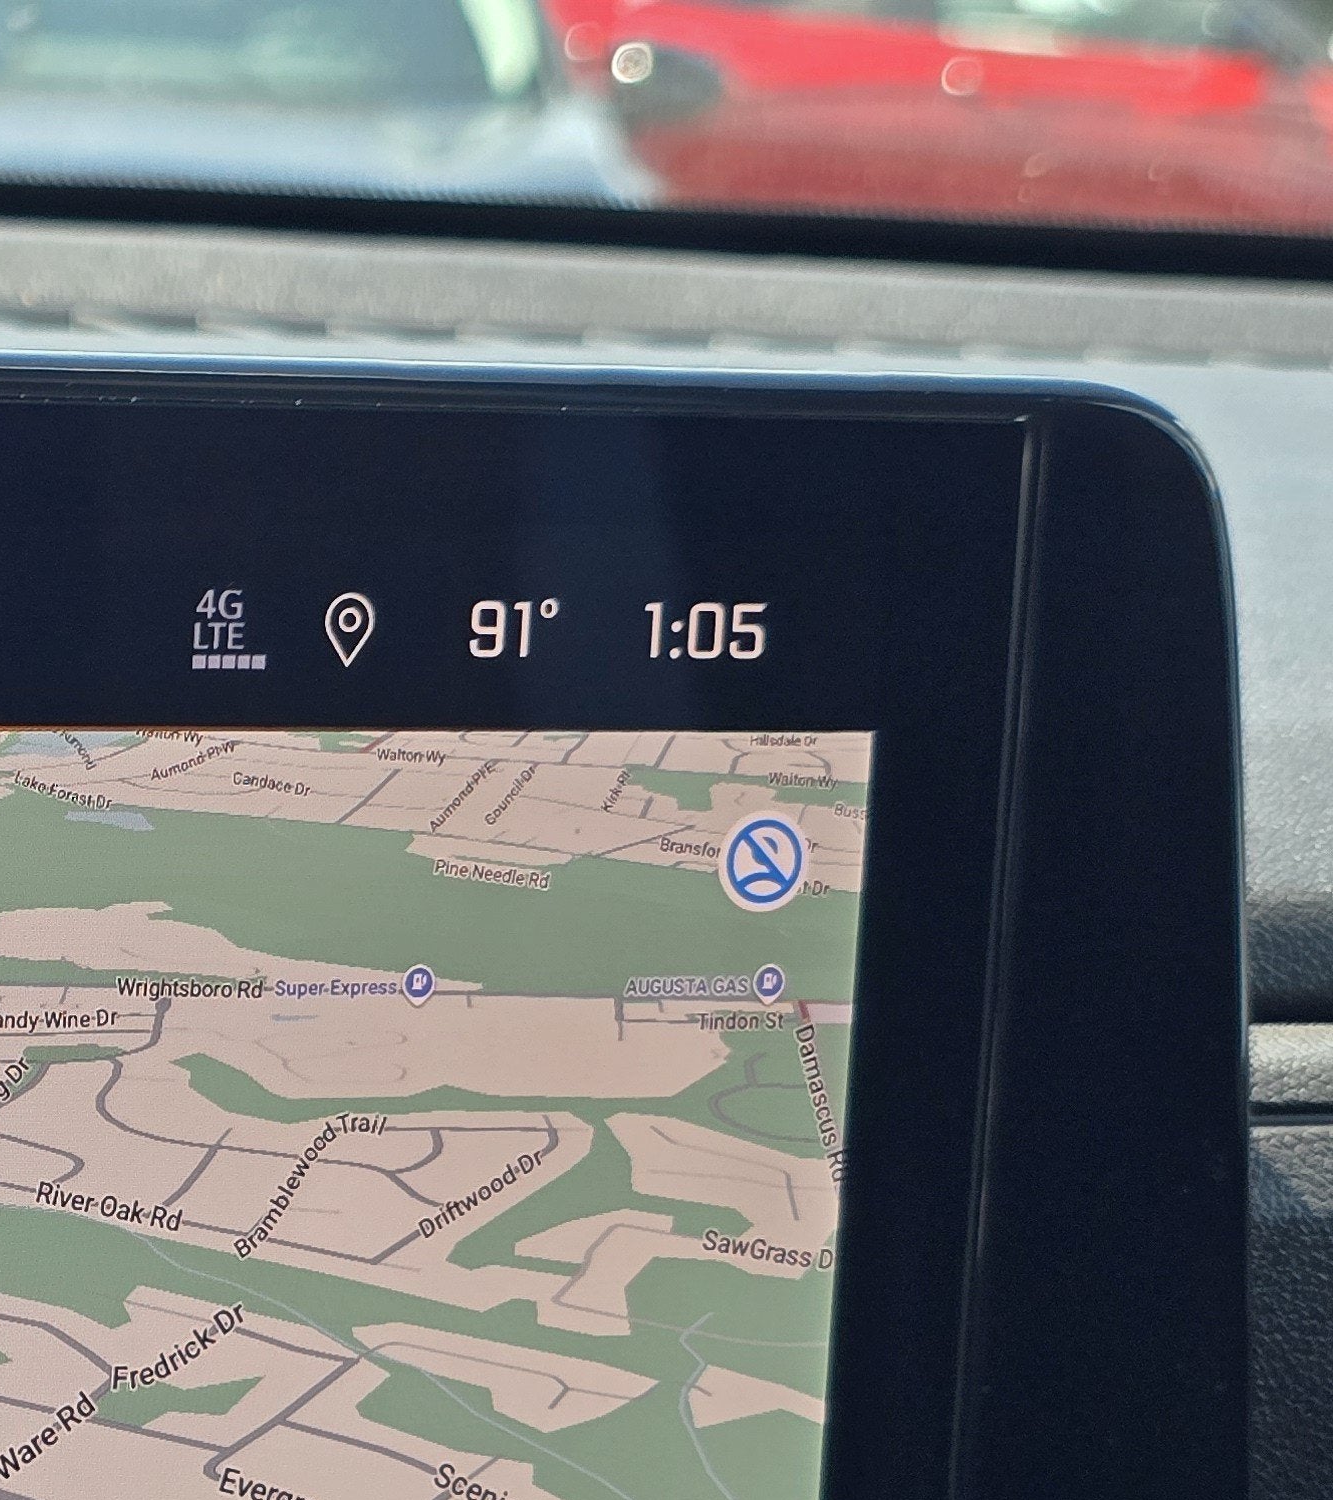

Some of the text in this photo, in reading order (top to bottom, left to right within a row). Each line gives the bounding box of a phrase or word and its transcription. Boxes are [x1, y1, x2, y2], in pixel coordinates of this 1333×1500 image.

[196, 588, 244, 619] 4G
[193, 621, 246, 650] LTE
[469, 598, 560, 659] 91°
[643, 601, 768, 660] 1:05
[151, 756, 205, 781] Aumond
[378, 749, 446, 767] Walton Wy
[233, 772, 311, 797] Candace Dr
[521, 765, 537, 783] Dr
[14, 771, 46, 793] Lake
[95, 795, 112, 810] Dr
[430, 779, 476, 833] Aumond
[435, 859, 549, 889] Pine Needle Rd
[117, 977, 263, 1002] Wrightsboro Rd
[626, 978, 748, 995] AUGUSTA GAS
[97, 1010, 118, 1026] Dr
[699, 1012, 783, 1030] Tindon St
[5, 1057, 31, 1085] Dr
[795, 1024, 837, 1147] Damascus
[233, 1113, 388, 1260] Bramblewood Trail
[418, 1149, 544, 1239] Driftwood Dr
[36, 1182, 183, 1232] River Oak Rd
[702, 1229, 812, 1269] SawGrass
[112, 1302, 245, 1390] Fredrick Dr
[55, 1391, 96, 1433] Rd
